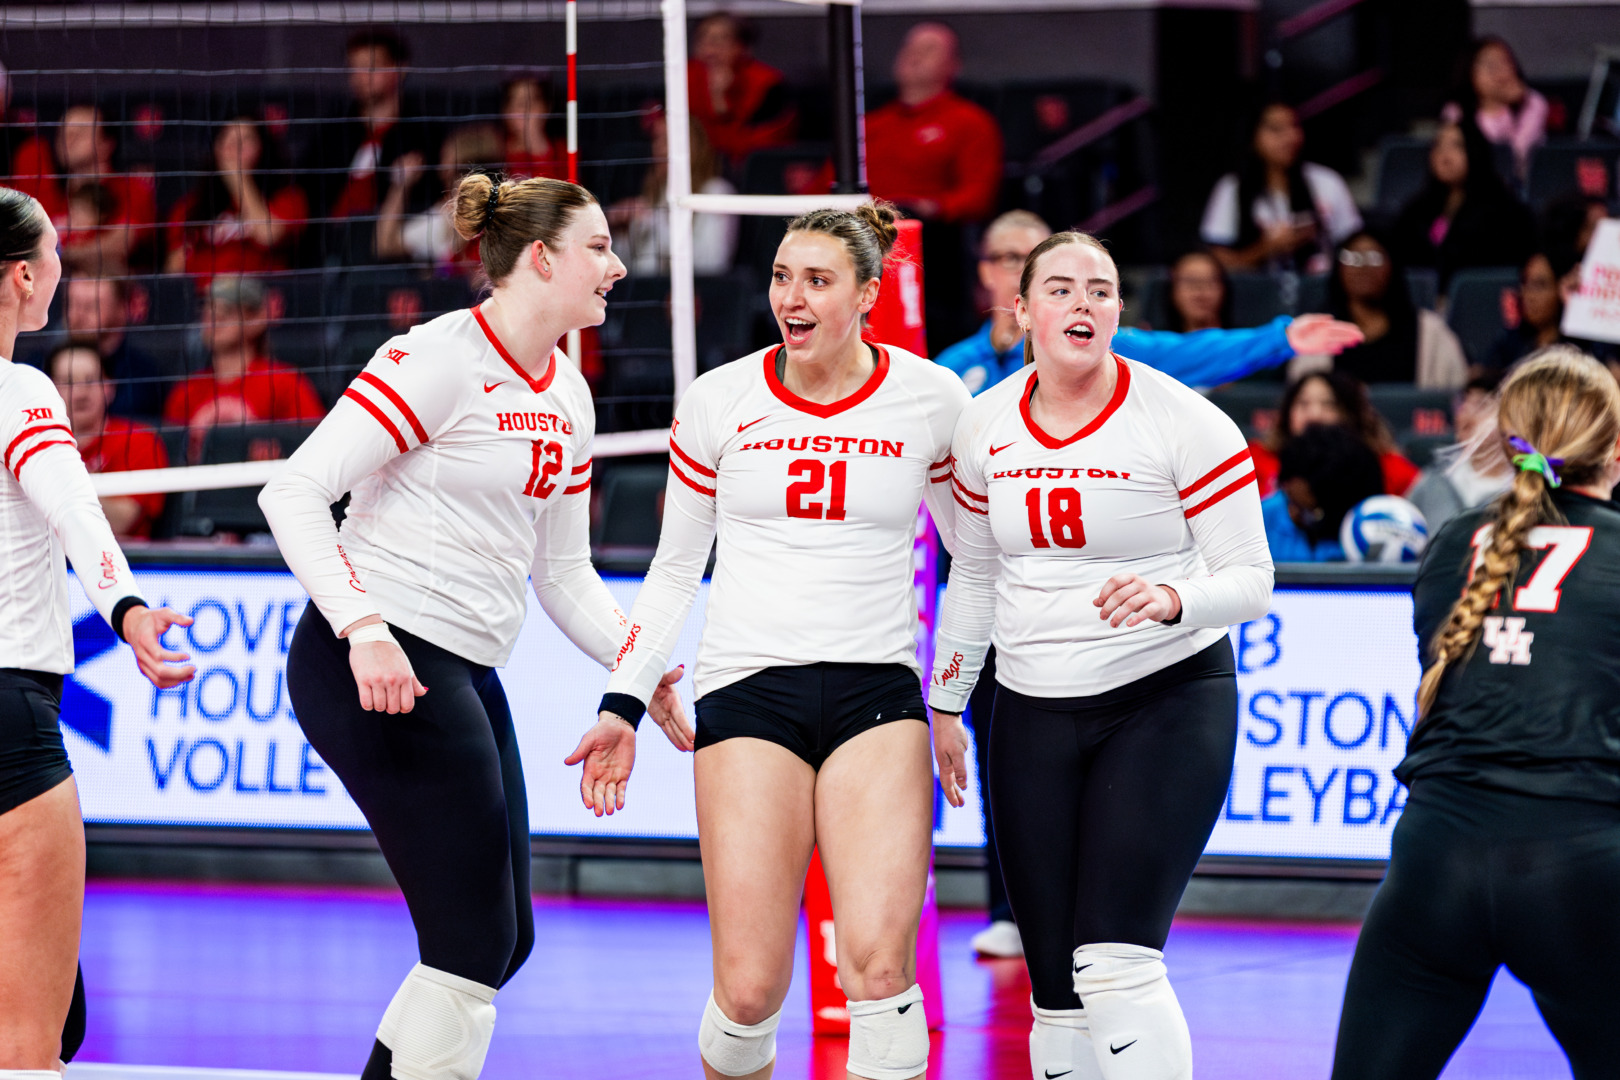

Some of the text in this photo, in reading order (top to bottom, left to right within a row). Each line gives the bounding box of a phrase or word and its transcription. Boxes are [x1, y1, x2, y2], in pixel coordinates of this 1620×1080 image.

[496, 412, 572, 435] HOUSTO
[521, 438, 563, 500] 12
[786, 458, 847, 521] 21
[1025, 487, 1087, 549] 18
[152, 667, 298, 722] HOU
